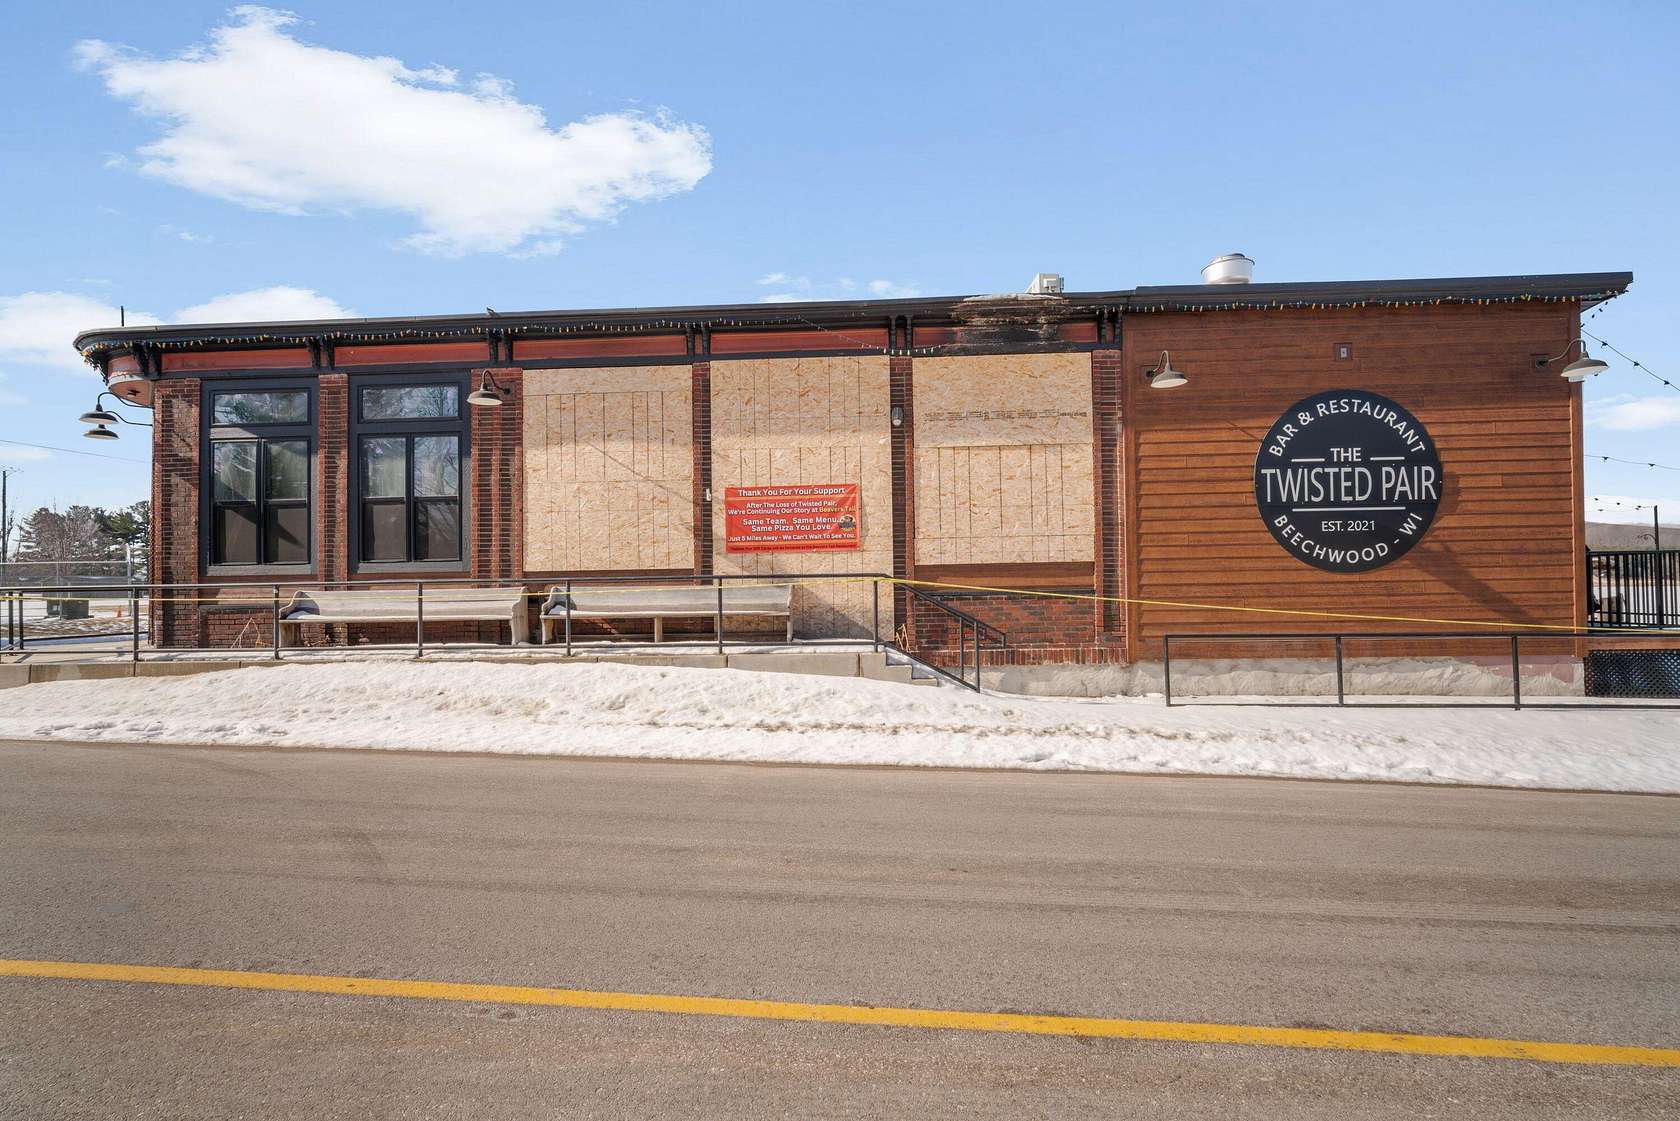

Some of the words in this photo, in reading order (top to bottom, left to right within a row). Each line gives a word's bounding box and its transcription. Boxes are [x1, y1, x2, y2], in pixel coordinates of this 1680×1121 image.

[1269, 423, 1299, 456] BAR
[1298, 411, 1314, 425] &
[1316, 399, 1426, 452] RESTAURANT
[1330, 447, 1361, 461] THE
[814, 487, 845, 495] Support
[1261, 467, 1372, 502] TWISTED
[1381, 466, 1437, 501] PAIR
[794, 507, 810, 515] Story
[1321, 520, 1343, 532] EST.
[1347, 520, 1375, 531] 2021
[1274, 514, 1389, 564] BEECHWOOD
[1399, 512, 1423, 536] WI
